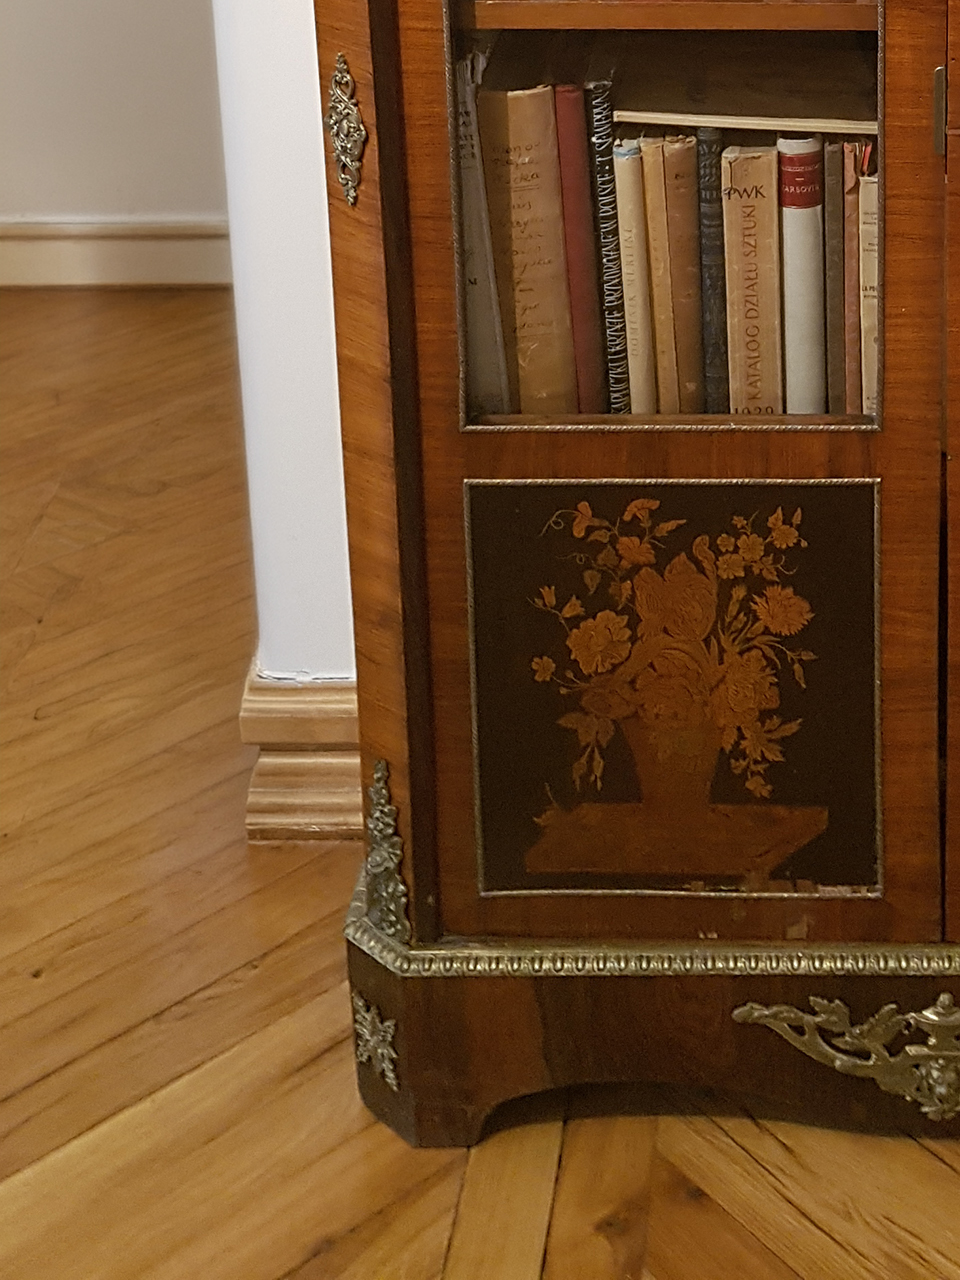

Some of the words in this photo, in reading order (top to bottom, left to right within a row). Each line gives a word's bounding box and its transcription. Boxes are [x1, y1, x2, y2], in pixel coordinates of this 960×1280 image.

[741, 204, 758, 261] SZTUKI
[743, 262, 760, 320] DZIAŁU
[744, 323, 761, 401] KATALOG
